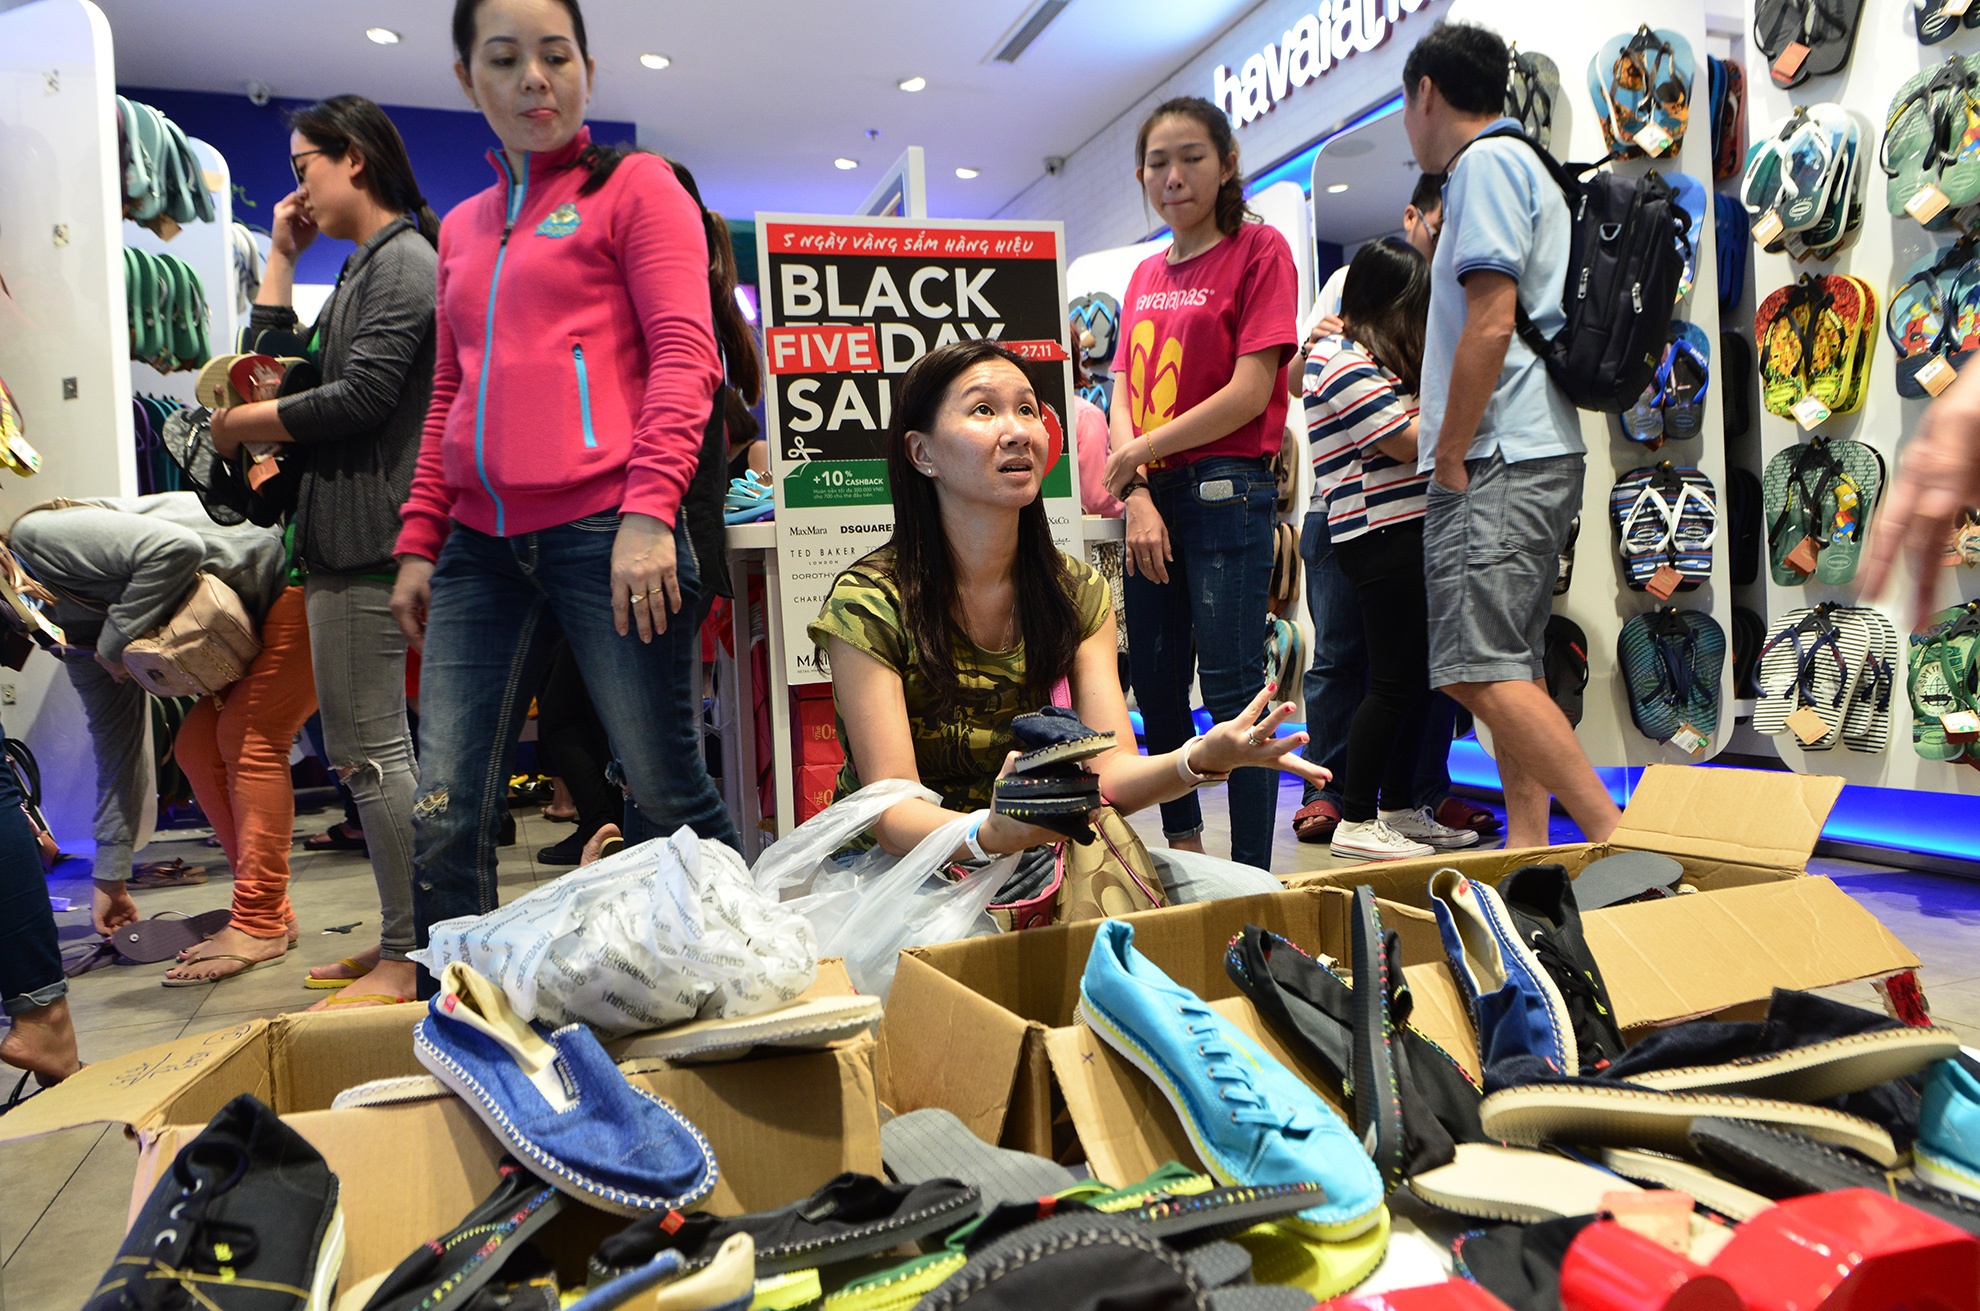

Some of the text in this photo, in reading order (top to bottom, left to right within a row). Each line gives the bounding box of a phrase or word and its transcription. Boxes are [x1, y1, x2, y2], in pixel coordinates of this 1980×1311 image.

[1214, 0, 1424, 130] havaia
[783, 230, 1034, 257] 5 NGÀY VÀNG SẮM HÀNG HIỆU
[780, 263, 1001, 319] BLACK
[773, 332, 873, 368] FIVE
[1021, 344, 1052, 358] 27.11
[787, 378, 891, 433] SAL
[845, 478, 884, 486] CASHBACK
[789, 525, 828, 536] MaxMara
[840, 523, 895, 534] DSQUARE
[790, 549, 811, 558] TED
[820, 547, 856, 557] BAKER
[792, 572, 837, 580] DOROTHY
